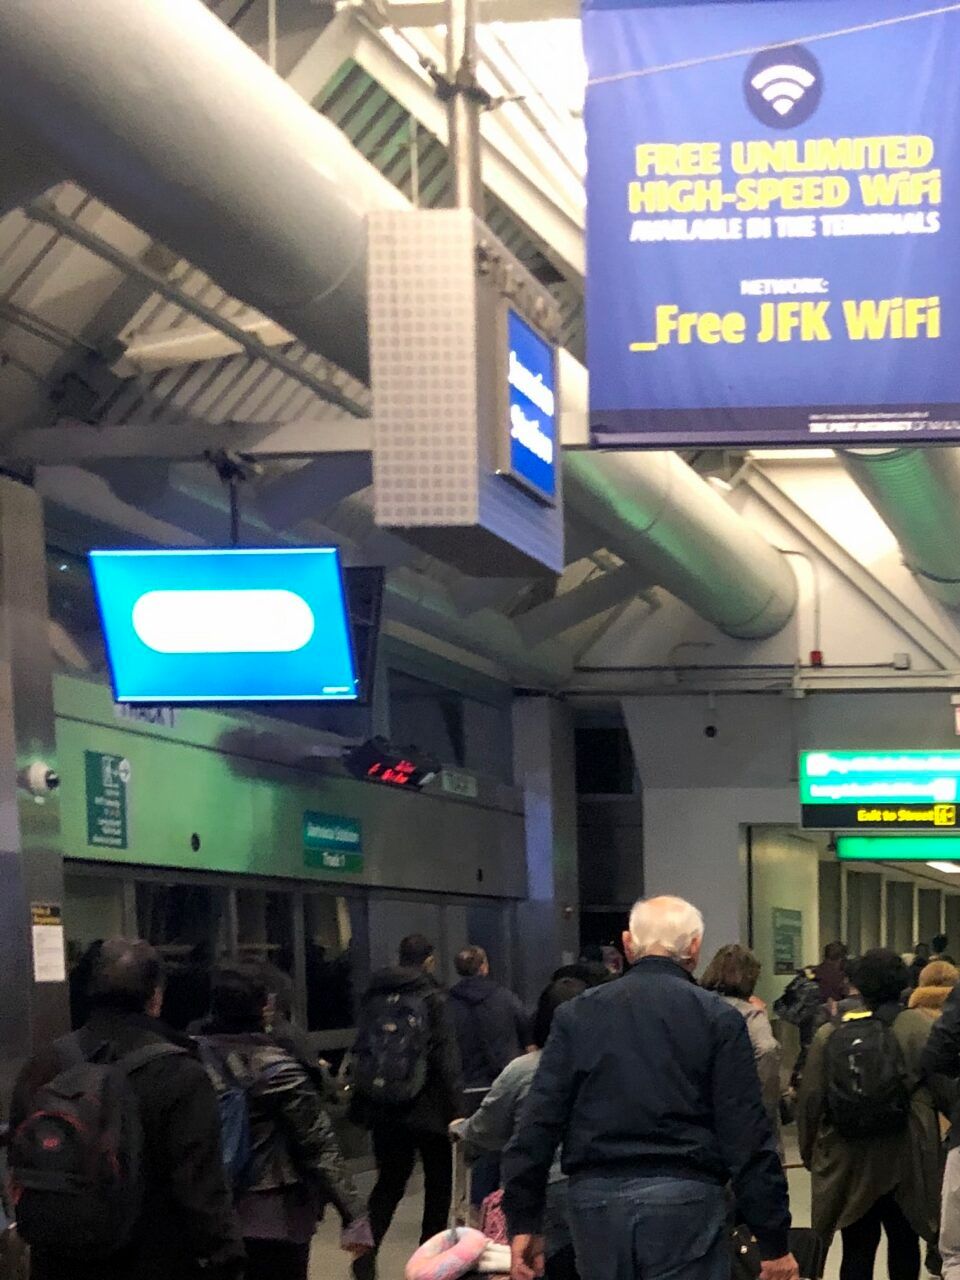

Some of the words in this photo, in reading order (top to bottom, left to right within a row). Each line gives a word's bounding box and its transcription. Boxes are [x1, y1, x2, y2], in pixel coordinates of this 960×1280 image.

[635, 142, 722, 177] FREE
[731, 135, 934, 175] UNLIMITED
[628, 175, 850, 213] HIGH-SPEED
[858, 169, 942, 207] WiFi
[629, 218, 743, 242] AVAILABLE
[746, 217, 772, 239] IN
[774, 215, 817, 238] THE
[818, 211, 941, 237] TERMINALS
[740, 278, 829, 295] NETWORK:
[757, 300, 832, 343] JFK
[841, 296, 942, 340] WiFi
